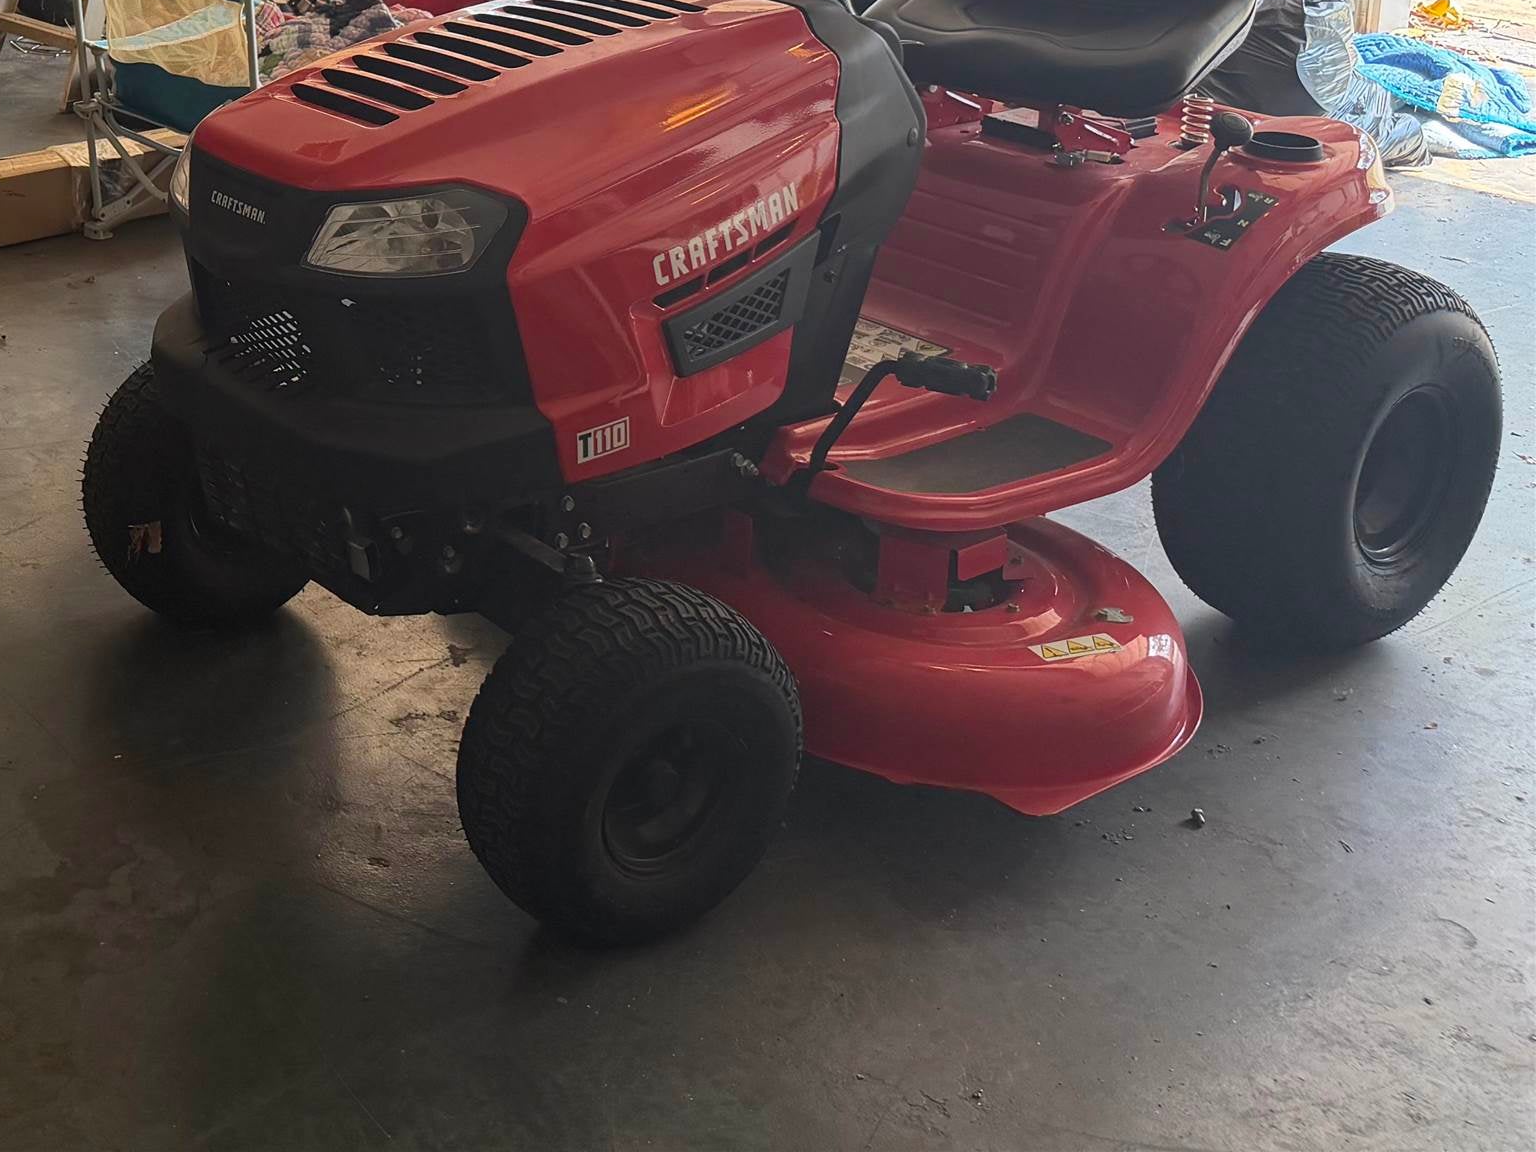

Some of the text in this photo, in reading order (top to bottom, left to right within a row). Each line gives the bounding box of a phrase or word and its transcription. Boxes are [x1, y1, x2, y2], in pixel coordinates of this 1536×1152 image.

[210, 190, 266, 225] CRAFTSMAN
[652, 181, 799, 286] CRAFTSMAN
[578, 422, 626, 458] T110
